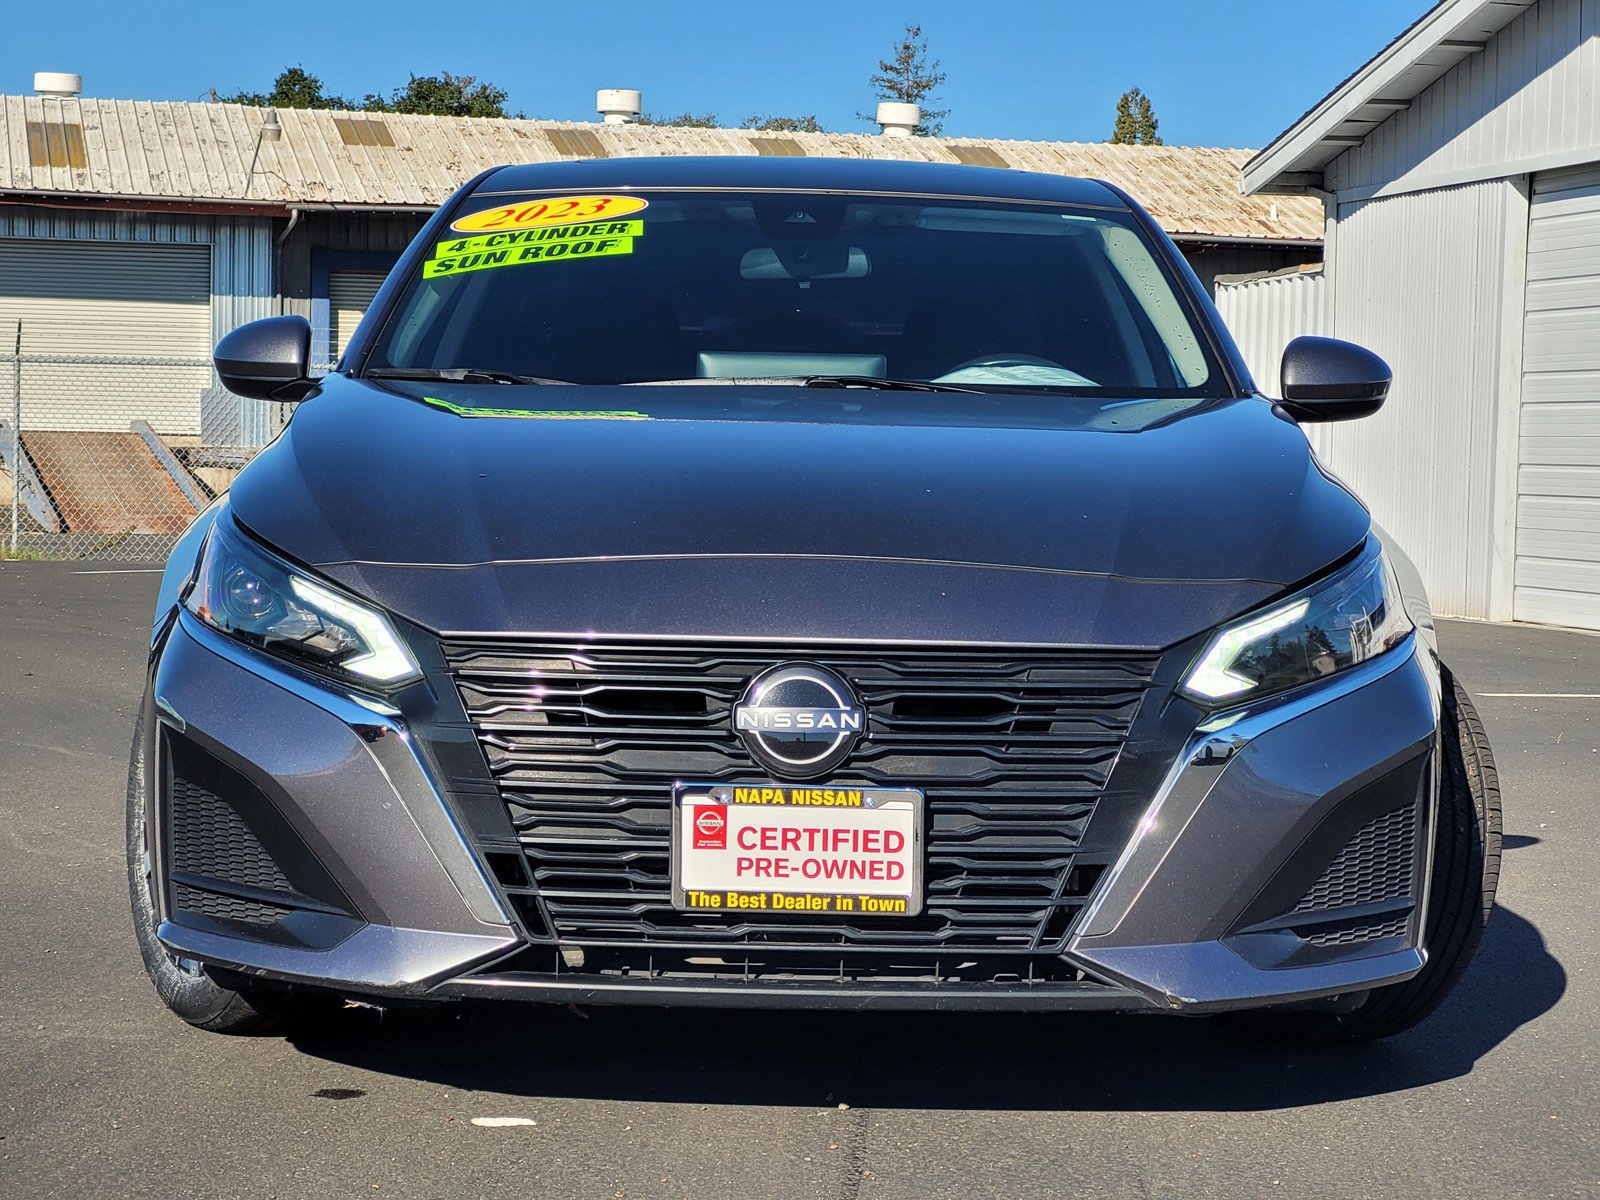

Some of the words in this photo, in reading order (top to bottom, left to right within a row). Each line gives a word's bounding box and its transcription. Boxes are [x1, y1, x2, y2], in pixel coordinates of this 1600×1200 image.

[481, 198, 612, 229] 2023
[446, 221, 632, 253] 4-CYLINDER
[432, 248, 511, 274] SUN
[518, 238, 622, 261] ROOF
[740, 711, 860, 729] NISSAN
[735, 788, 785, 805] NAPA
[791, 789, 861, 807] NISSAN
[736, 826, 905, 854] CERTIFIED
[736, 857, 905, 880] PRE-OWNED
[688, 891, 721, 908] The
[726, 891, 767, 909] Best
[772, 892, 831, 910] Dealer
[836, 893, 853, 911] in
[858, 895, 906, 913] Town
